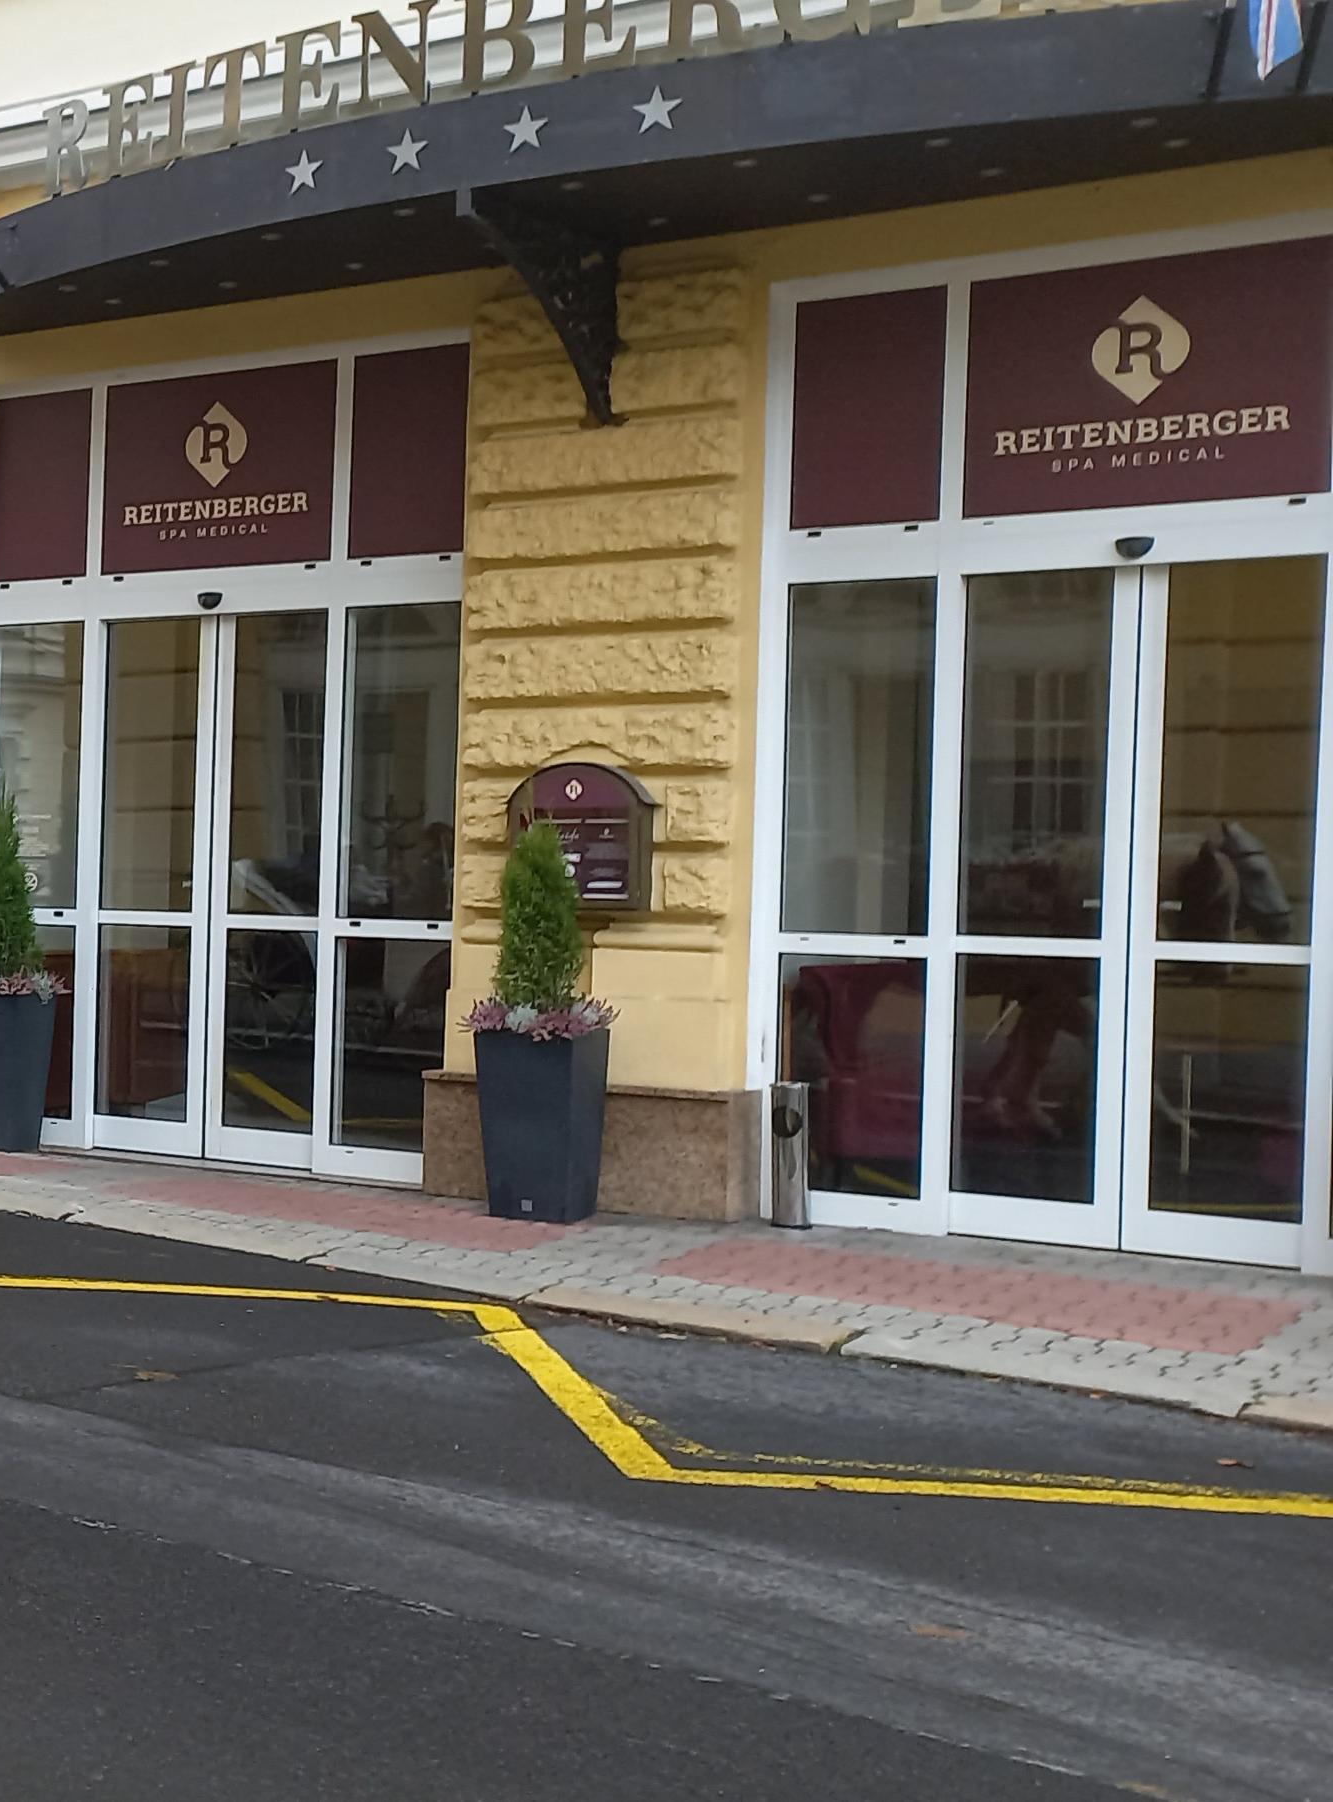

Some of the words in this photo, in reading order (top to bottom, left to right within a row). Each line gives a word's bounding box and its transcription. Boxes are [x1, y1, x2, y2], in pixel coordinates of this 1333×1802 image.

[42, 0, 1083, 196] REITENBE
[994, 405, 1290, 456] REITENBERGER
[1052, 457, 1095, 473] SPA
[1111, 446, 1225, 469] MEDICAL
[123, 492, 309, 526] REITENBERGER
[196, 523, 268, 538] MEDICAL
